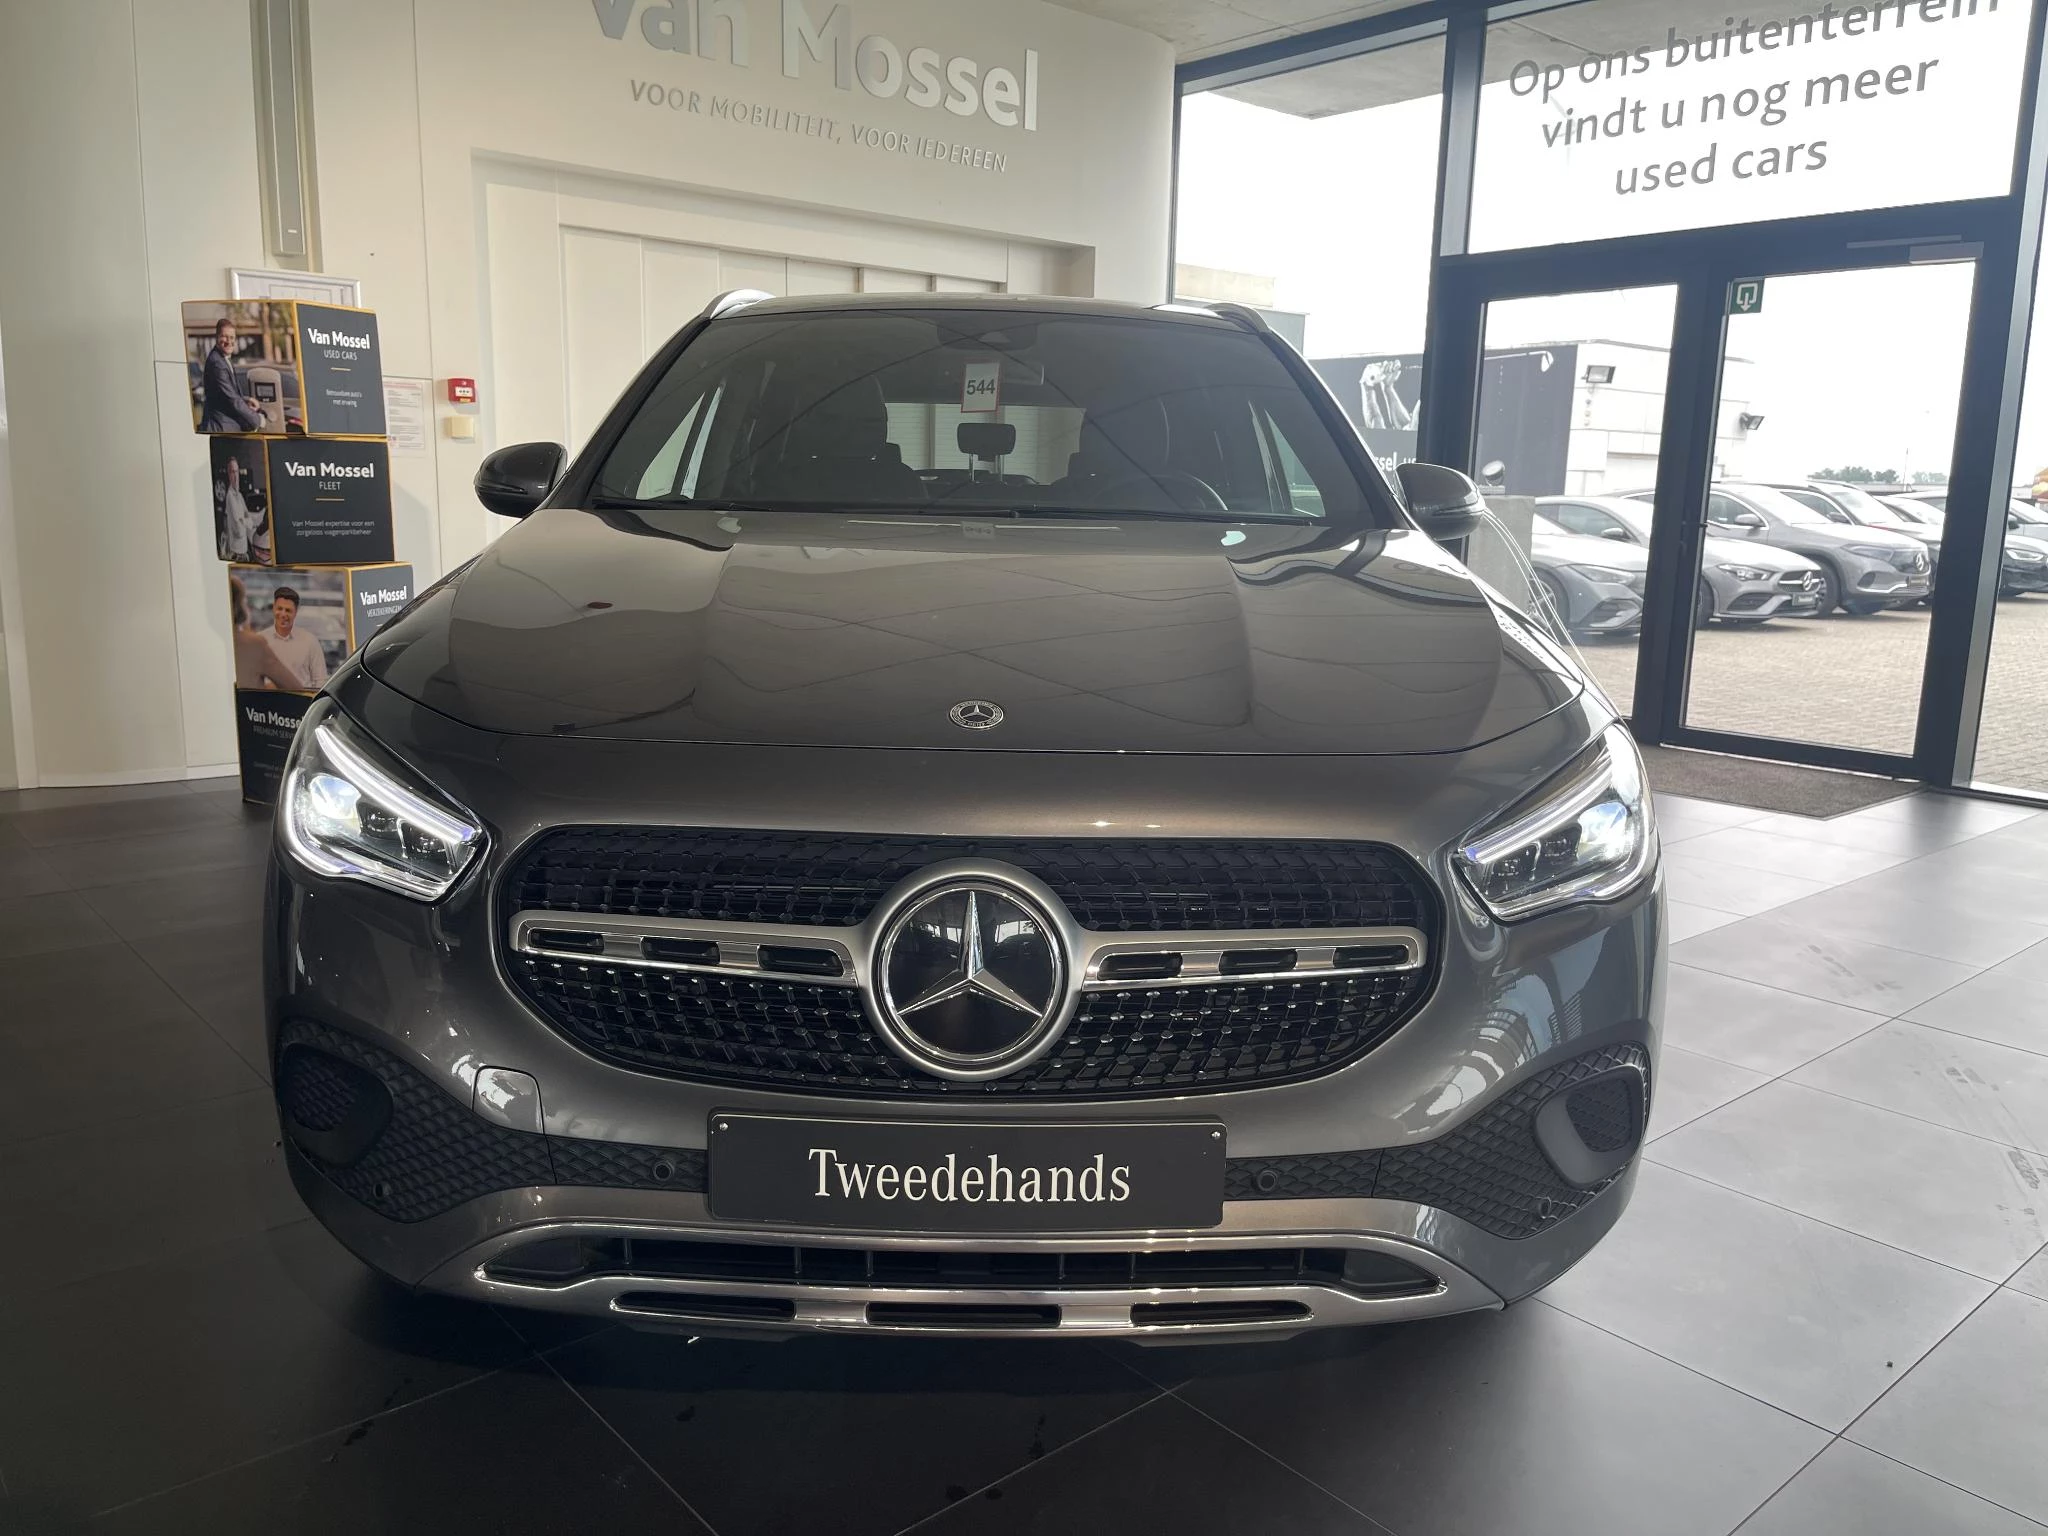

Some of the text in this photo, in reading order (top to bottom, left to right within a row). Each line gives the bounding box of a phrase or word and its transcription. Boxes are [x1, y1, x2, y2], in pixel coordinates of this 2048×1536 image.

[781, 0, 1039, 132] Mossel
[1510, 60, 1565, 104] Op
[1578, 45, 1651, 83] ons
[1542, 59, 1939, 148] vindt u nog meer
[630, 79, 1008, 173] VOOR MOBILITEIT, VOOR IEDEREEN
[1615, 141, 1827, 195] used cars
[307, 327, 371, 349] Van Mossel
[323, 349, 357, 360] USED CARS
[966, 379, 996, 395] 544
[285, 462, 375, 478] Van Mossel
[1374, 452, 1398, 471] sel
[319, 481, 341, 490] FLEET
[360, 585, 407, 606] Van Mossel
[245, 706, 305, 729] Van Mosse
[808, 1148, 1131, 1202] Tweedehands
